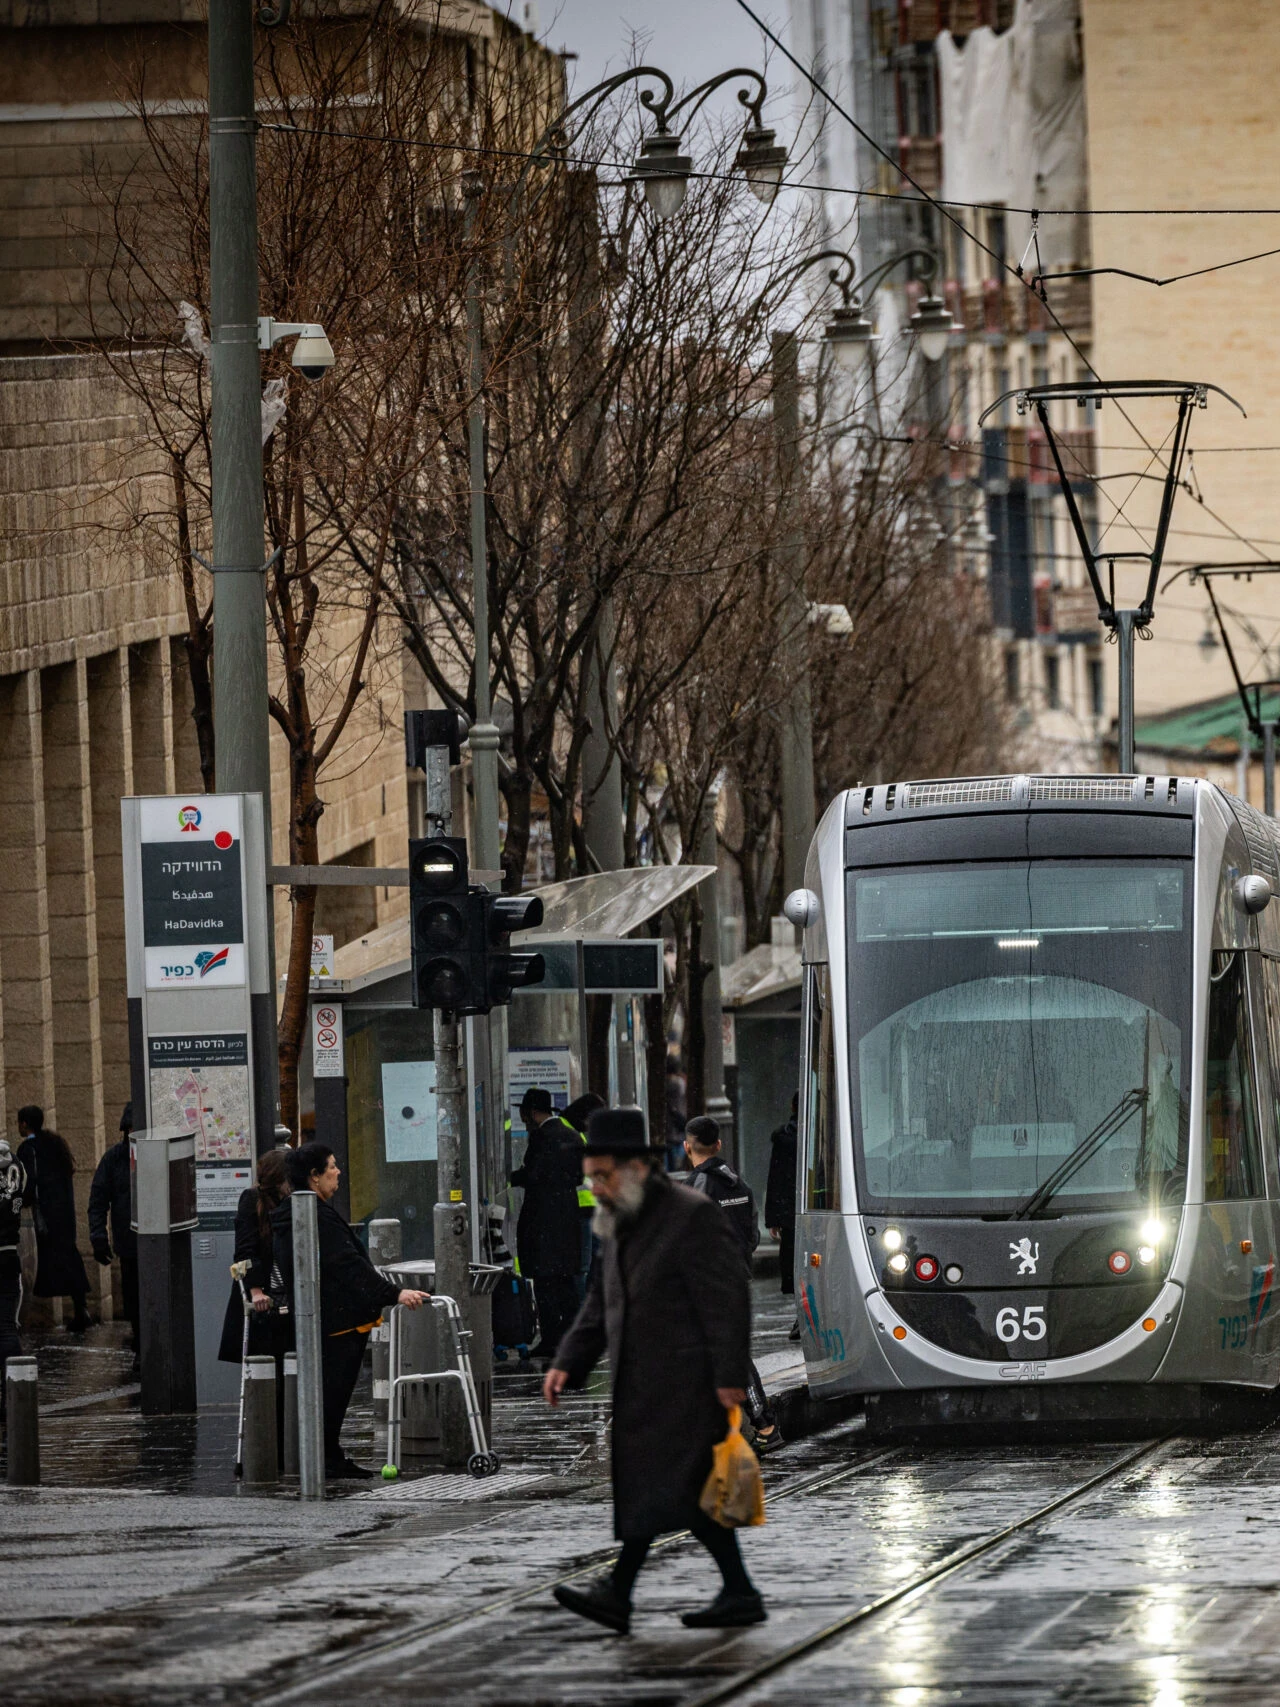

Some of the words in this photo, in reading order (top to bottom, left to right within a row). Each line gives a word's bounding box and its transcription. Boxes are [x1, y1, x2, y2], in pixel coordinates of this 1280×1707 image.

[162, 860, 222, 875] הדווידקה
[164, 918, 224, 929] HaDavidka
[160, 965, 194, 977] כפיר
[153, 1041, 174, 1050] כרם
[177, 1040, 192, 1051] עין
[194, 1039, 225, 1049] הדסה
[453, 1215, 464, 1236] 3
[995, 1306, 1047, 1342] 65
[1218, 1315, 1248, 1350] כפיר
[999, 1362, 1047, 1380] CAF
